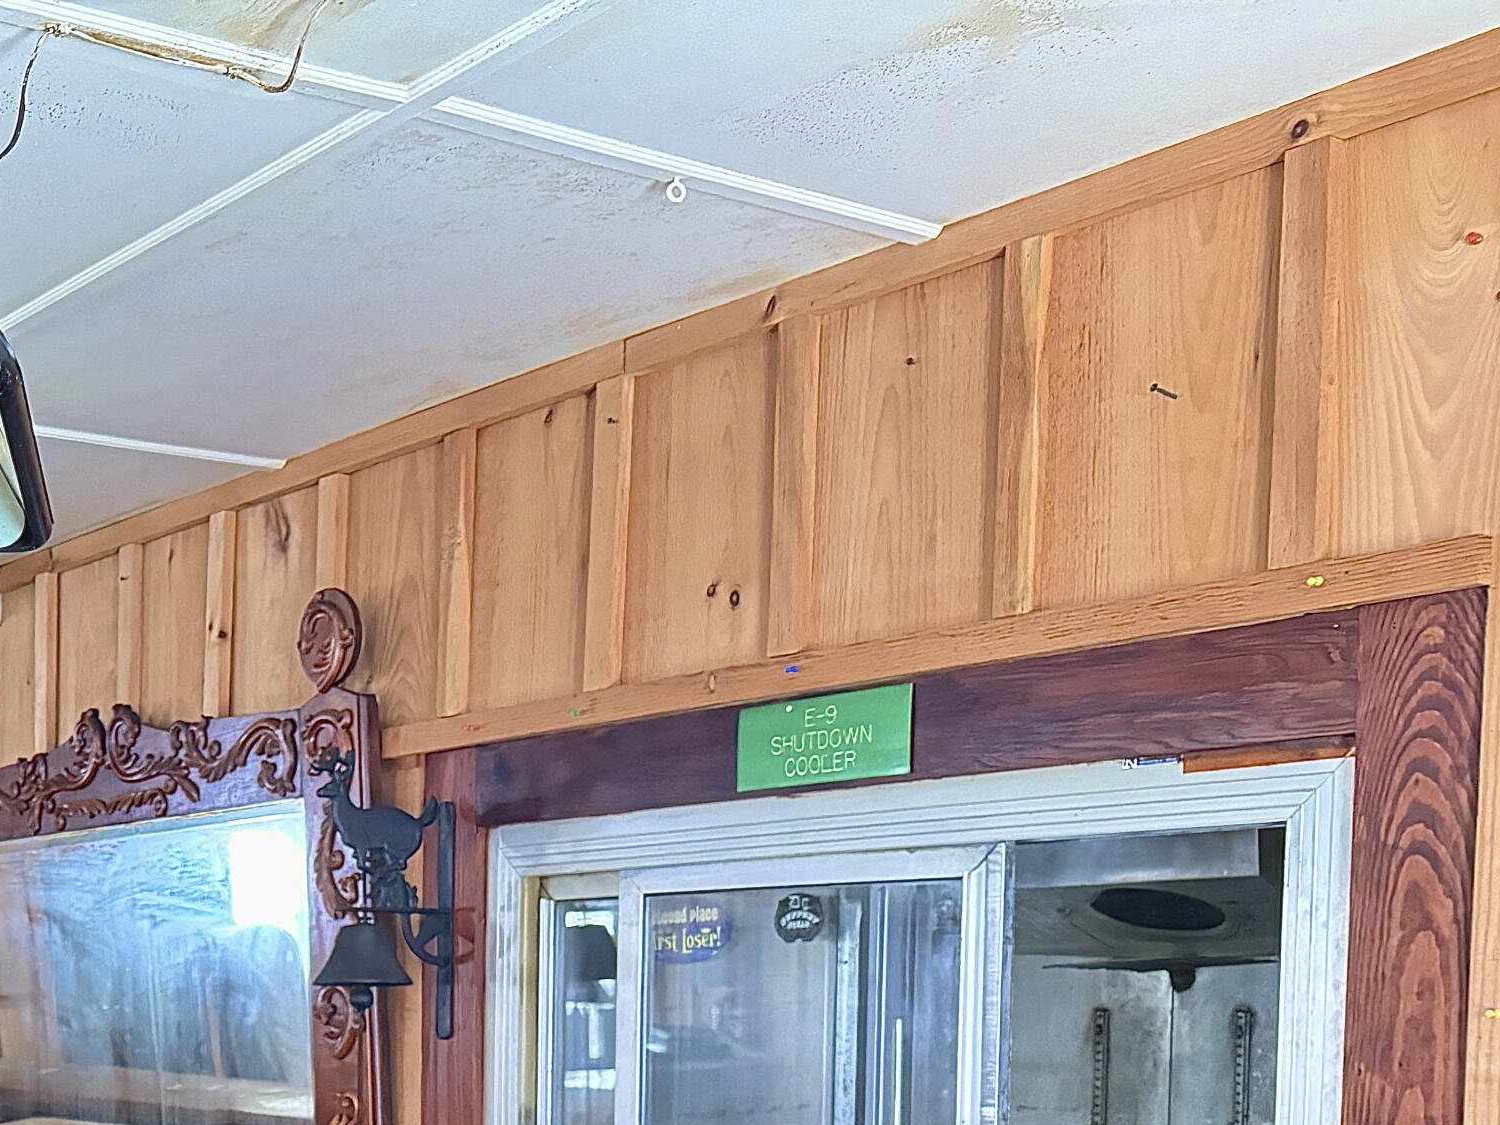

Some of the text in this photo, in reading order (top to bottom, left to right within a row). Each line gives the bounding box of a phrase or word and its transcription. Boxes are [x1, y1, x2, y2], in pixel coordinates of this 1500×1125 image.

[804, 704, 838, 728] E-9
[770, 724, 873, 756] SHUTDOWN
[784, 750, 857, 778] COOLER
